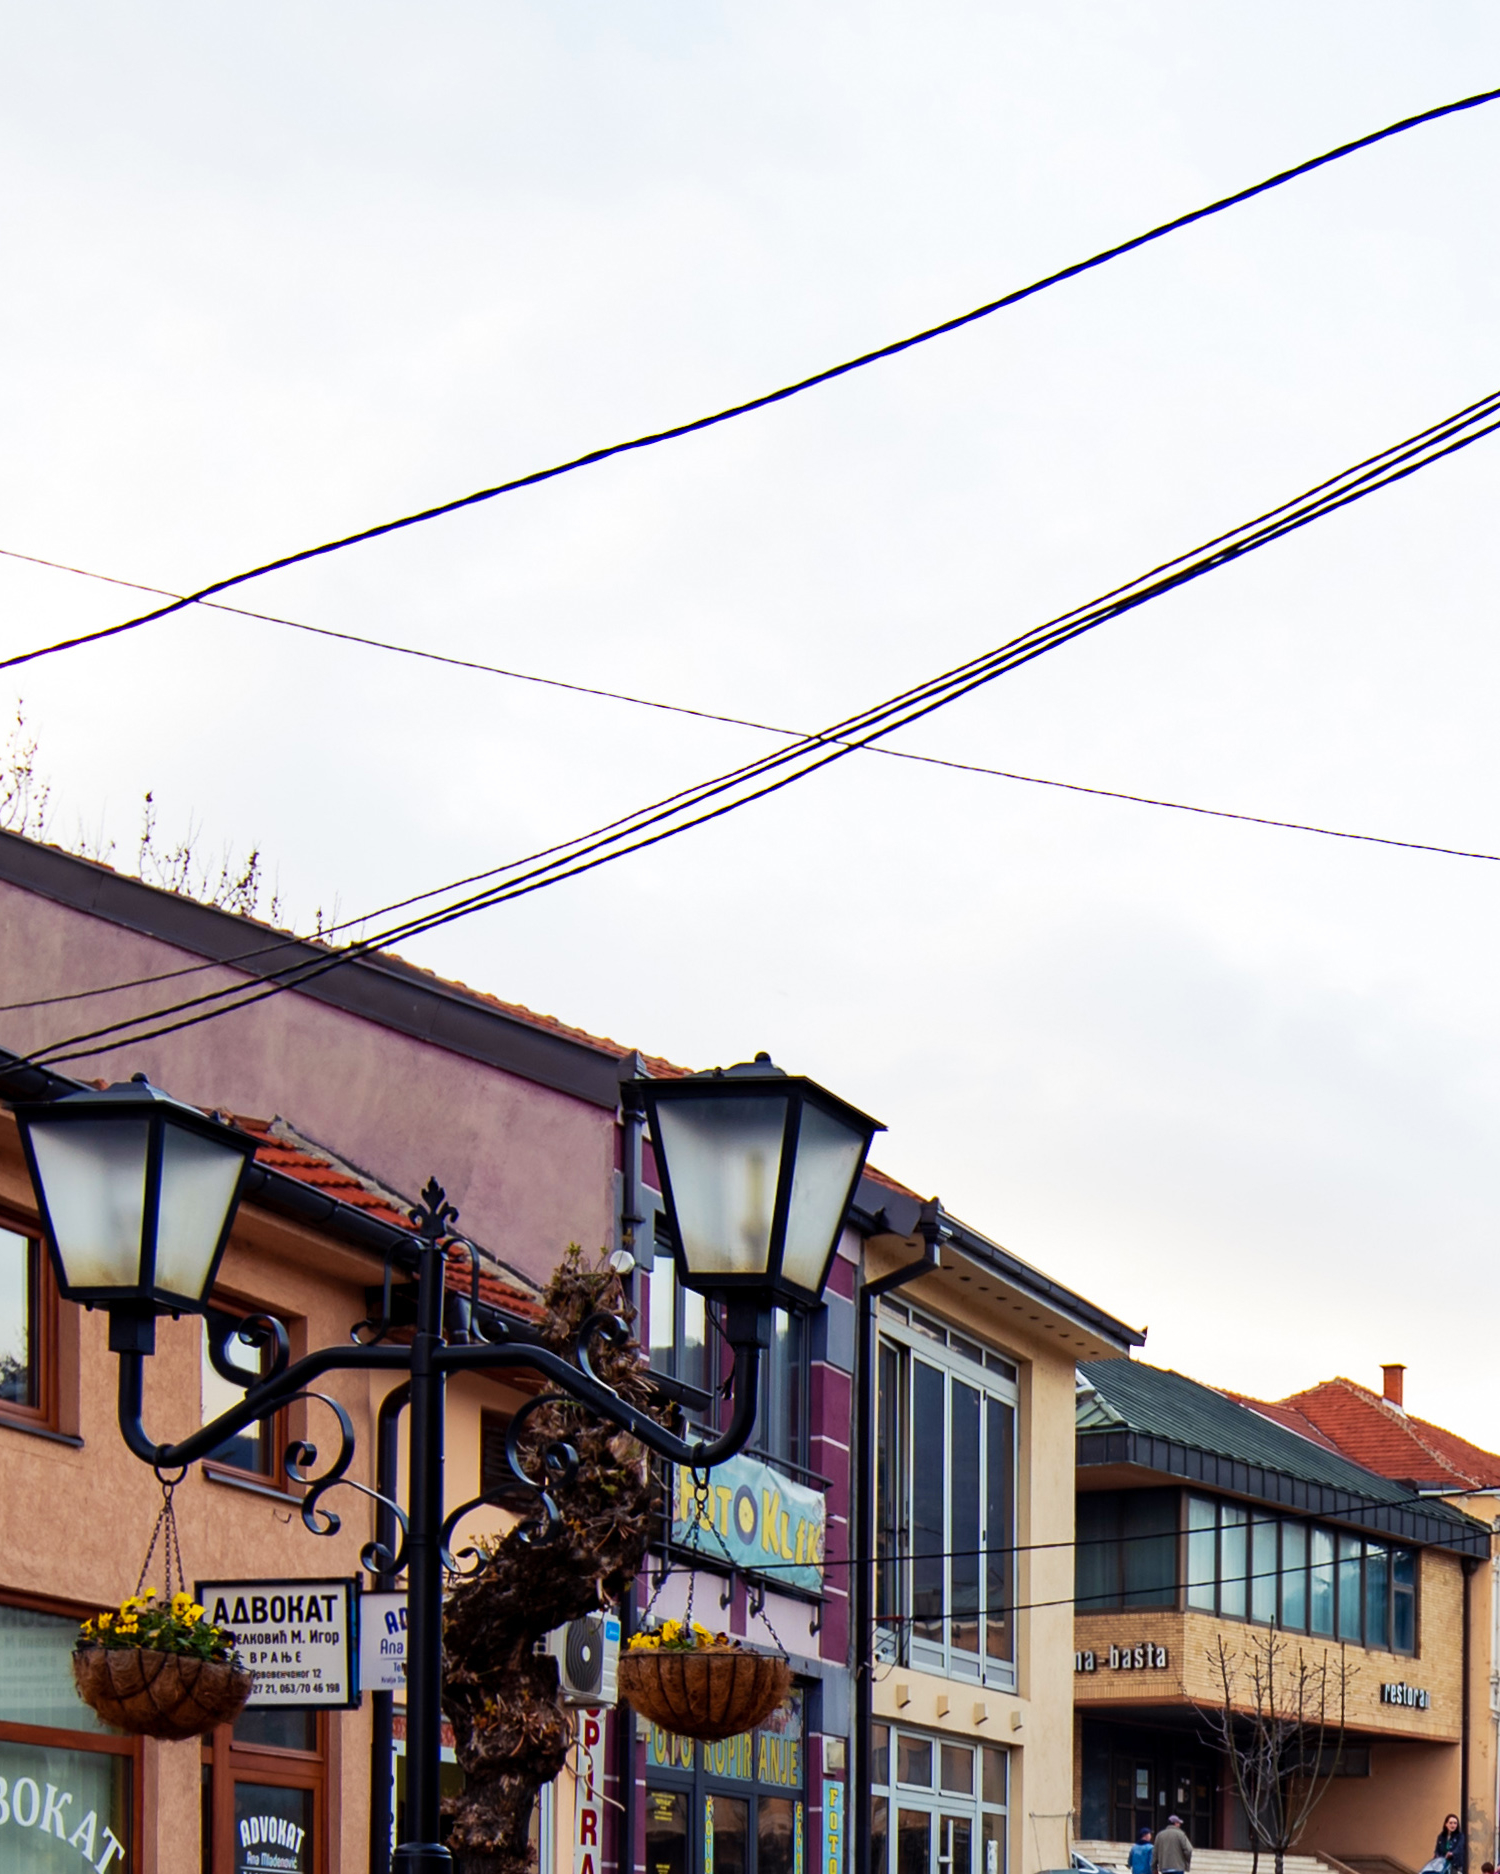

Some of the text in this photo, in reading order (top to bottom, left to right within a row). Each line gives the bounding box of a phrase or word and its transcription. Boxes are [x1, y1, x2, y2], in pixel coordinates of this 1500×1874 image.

[212, 1594, 339, 1625] АДВОКАТ
[234, 1630, 340, 1646] елковић М. Игор
[380, 1638, 404, 1655] Ana
[249, 1651, 302, 1664] ВРАЊЕ
[312, 1668, 322, 1679] 12
[240, 1815, 306, 1854] ADVOKAT
[246, 1851, 260, 1866] Ana
